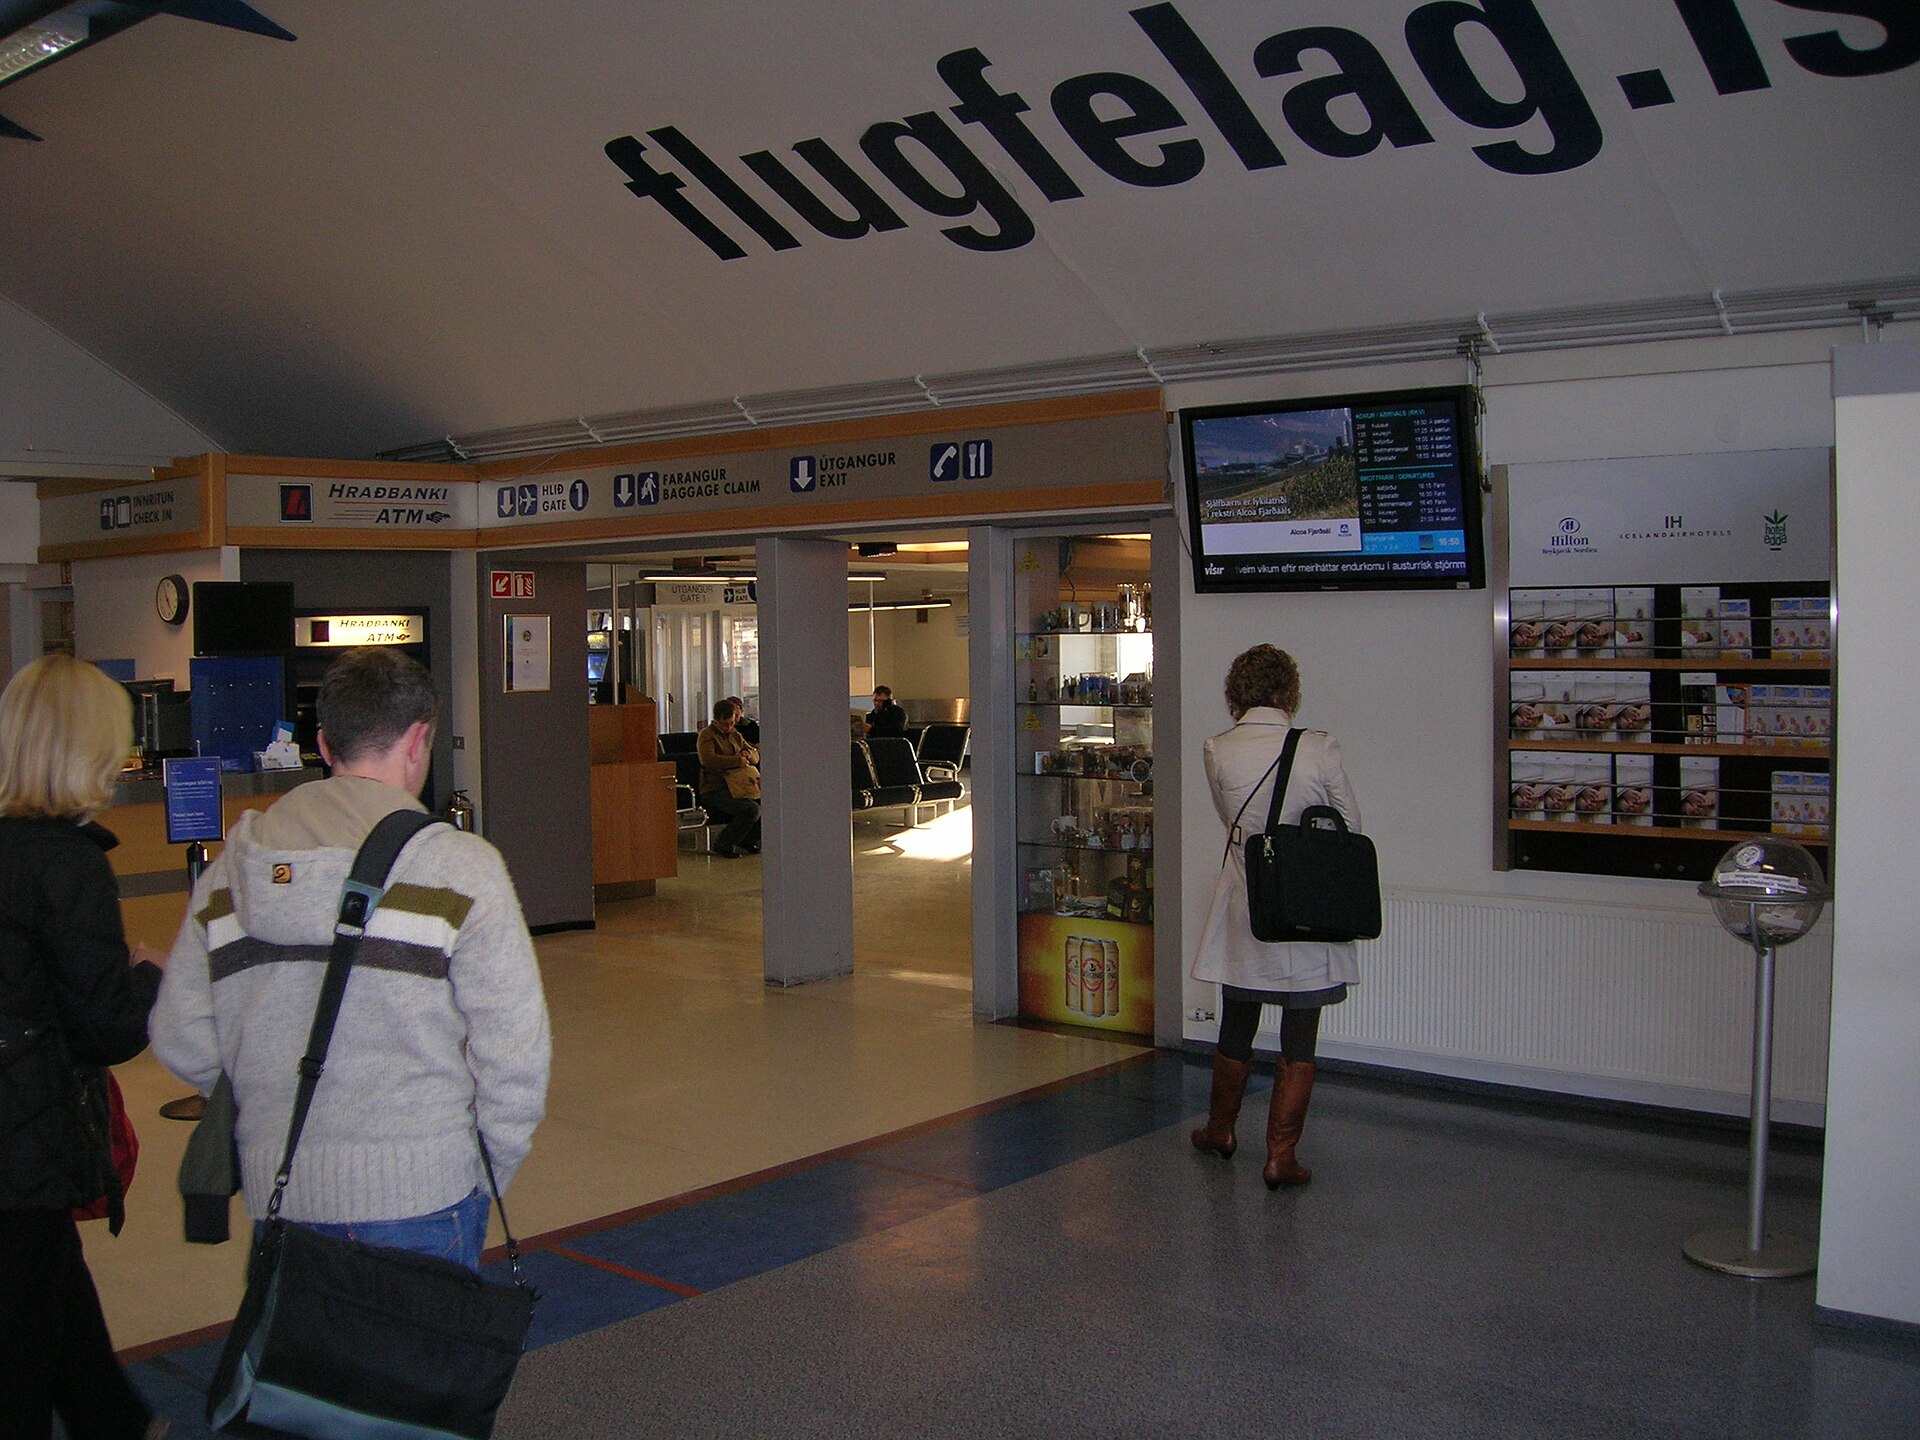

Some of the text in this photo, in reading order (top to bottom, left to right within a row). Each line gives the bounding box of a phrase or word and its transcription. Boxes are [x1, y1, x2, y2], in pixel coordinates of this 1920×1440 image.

[819, 452, 896, 471] ÚTGANGUR
[662, 468, 727, 487] FARANGUR
[819, 473, 847, 487] EXIT
[328, 484, 449, 500] HRAÐBANKI
[542, 482, 584, 508] HLIÐ 1
[662, 479, 761, 501] BAGGAGE CLAIM
[133, 490, 174, 507] INNRITUN
[542, 500, 567, 512] GATE
[133, 509, 173, 525] CHECK IN
[375, 509, 424, 525] ATM
[1236, 508, 1257, 517] Alcoa
[1665, 515, 1683, 529] IH
[1551, 535, 1589, 546] Hilton
[1281, 563, 1296, 573] eftir
[1341, 561, 1385, 572] endurkomu
[680, 593, 700, 602] GATE
[366, 633, 396, 642] ATM
